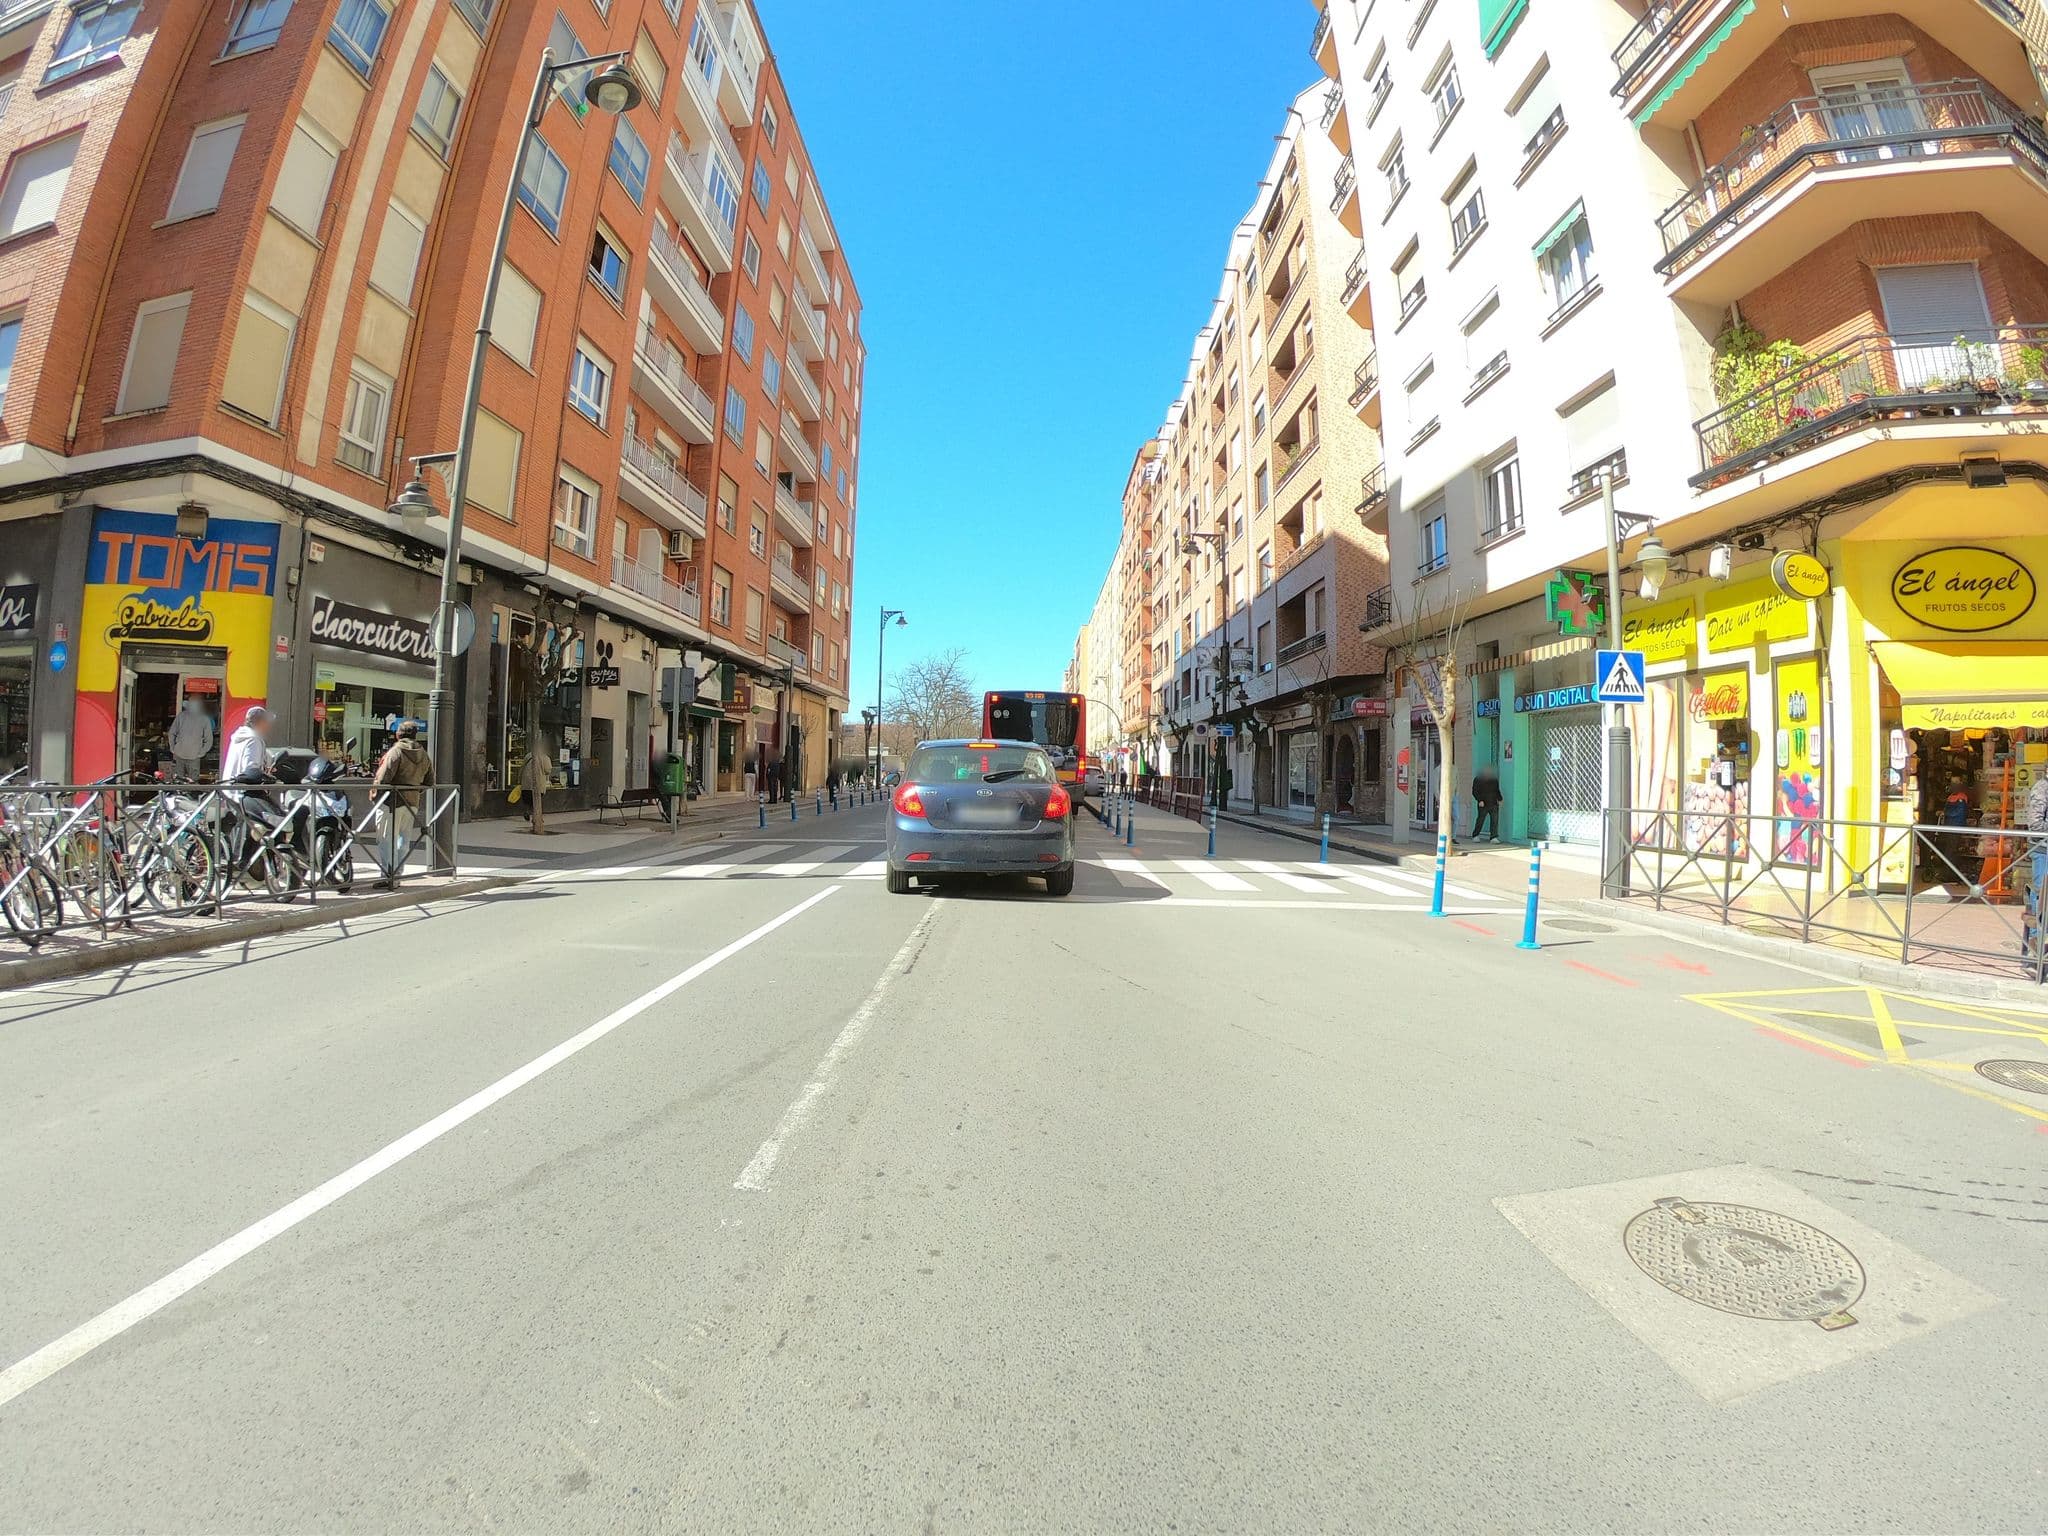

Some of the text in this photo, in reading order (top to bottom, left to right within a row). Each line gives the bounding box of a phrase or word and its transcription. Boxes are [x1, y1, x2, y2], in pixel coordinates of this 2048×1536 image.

[1787, 564, 1799, 578] El
[1899, 569, 2020, 599] El ángel
[1925, 603, 2006, 612] FRUTOS SECOS
[120, 602, 199, 636] Gabriela
[1623, 608, 1690, 644] El ángel
[1737, 608, 1751, 626] un
[1661, 639, 1686, 650] SECOS
[1548, 686, 1590, 707] DIGITAL
[1930, 707, 2016, 722] Napolitanas
